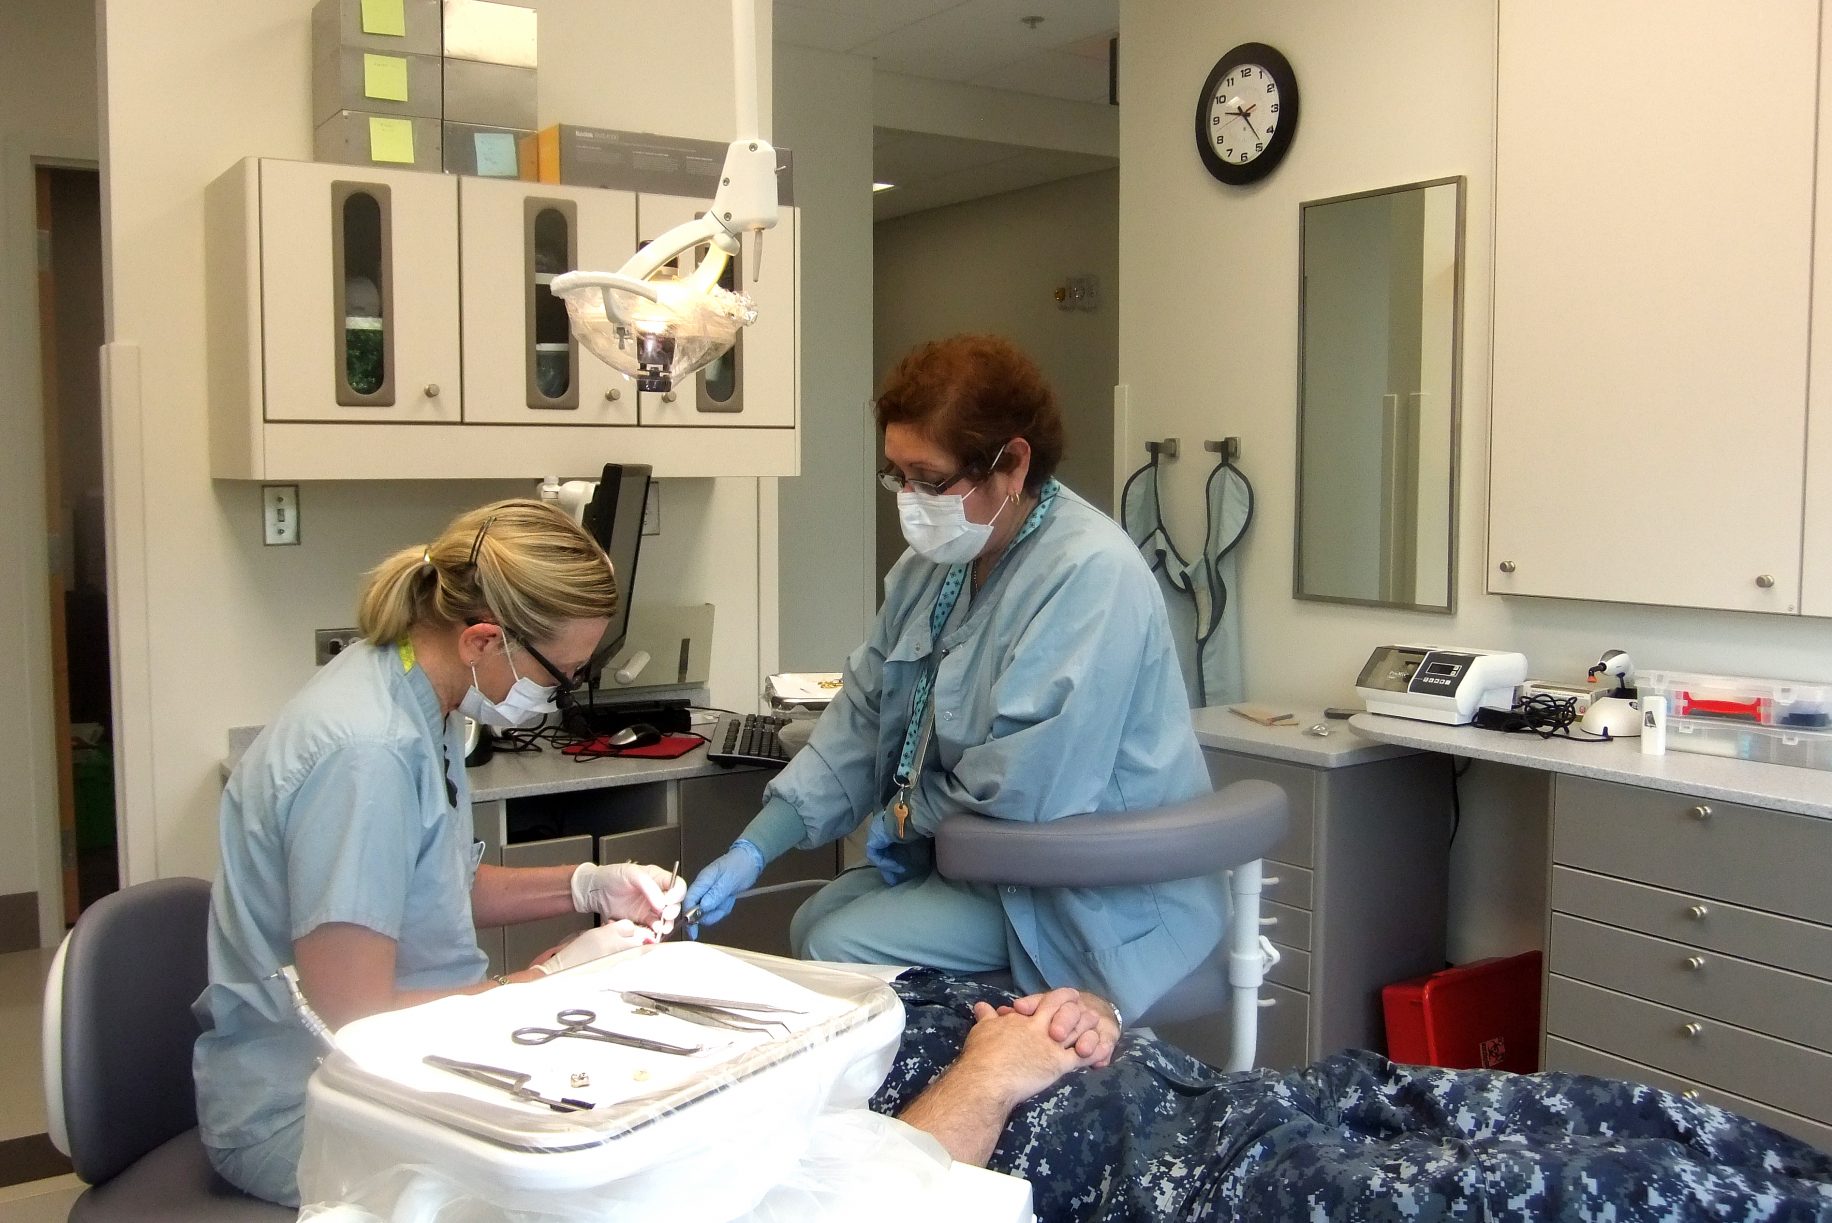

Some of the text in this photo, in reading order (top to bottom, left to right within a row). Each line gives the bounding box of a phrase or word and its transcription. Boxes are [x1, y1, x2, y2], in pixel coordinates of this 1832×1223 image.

[1241, 68, 1252, 78] 12
[1259, 70, 1263, 79] 1
[1226, 78, 1235, 87] 11
[1267, 84, 1275, 93] 2
[1215, 95, 1226, 104] 10
[1271, 104, 1279, 113] 3
[1213, 116, 1220, 125] 9
[1266, 126, 1274, 134] 4
[1217, 136, 1224, 144] 8
[1256, 143, 1263, 152] 5
[1226, 149, 1233, 157] 7
[1241, 153, 1248, 162] 6
